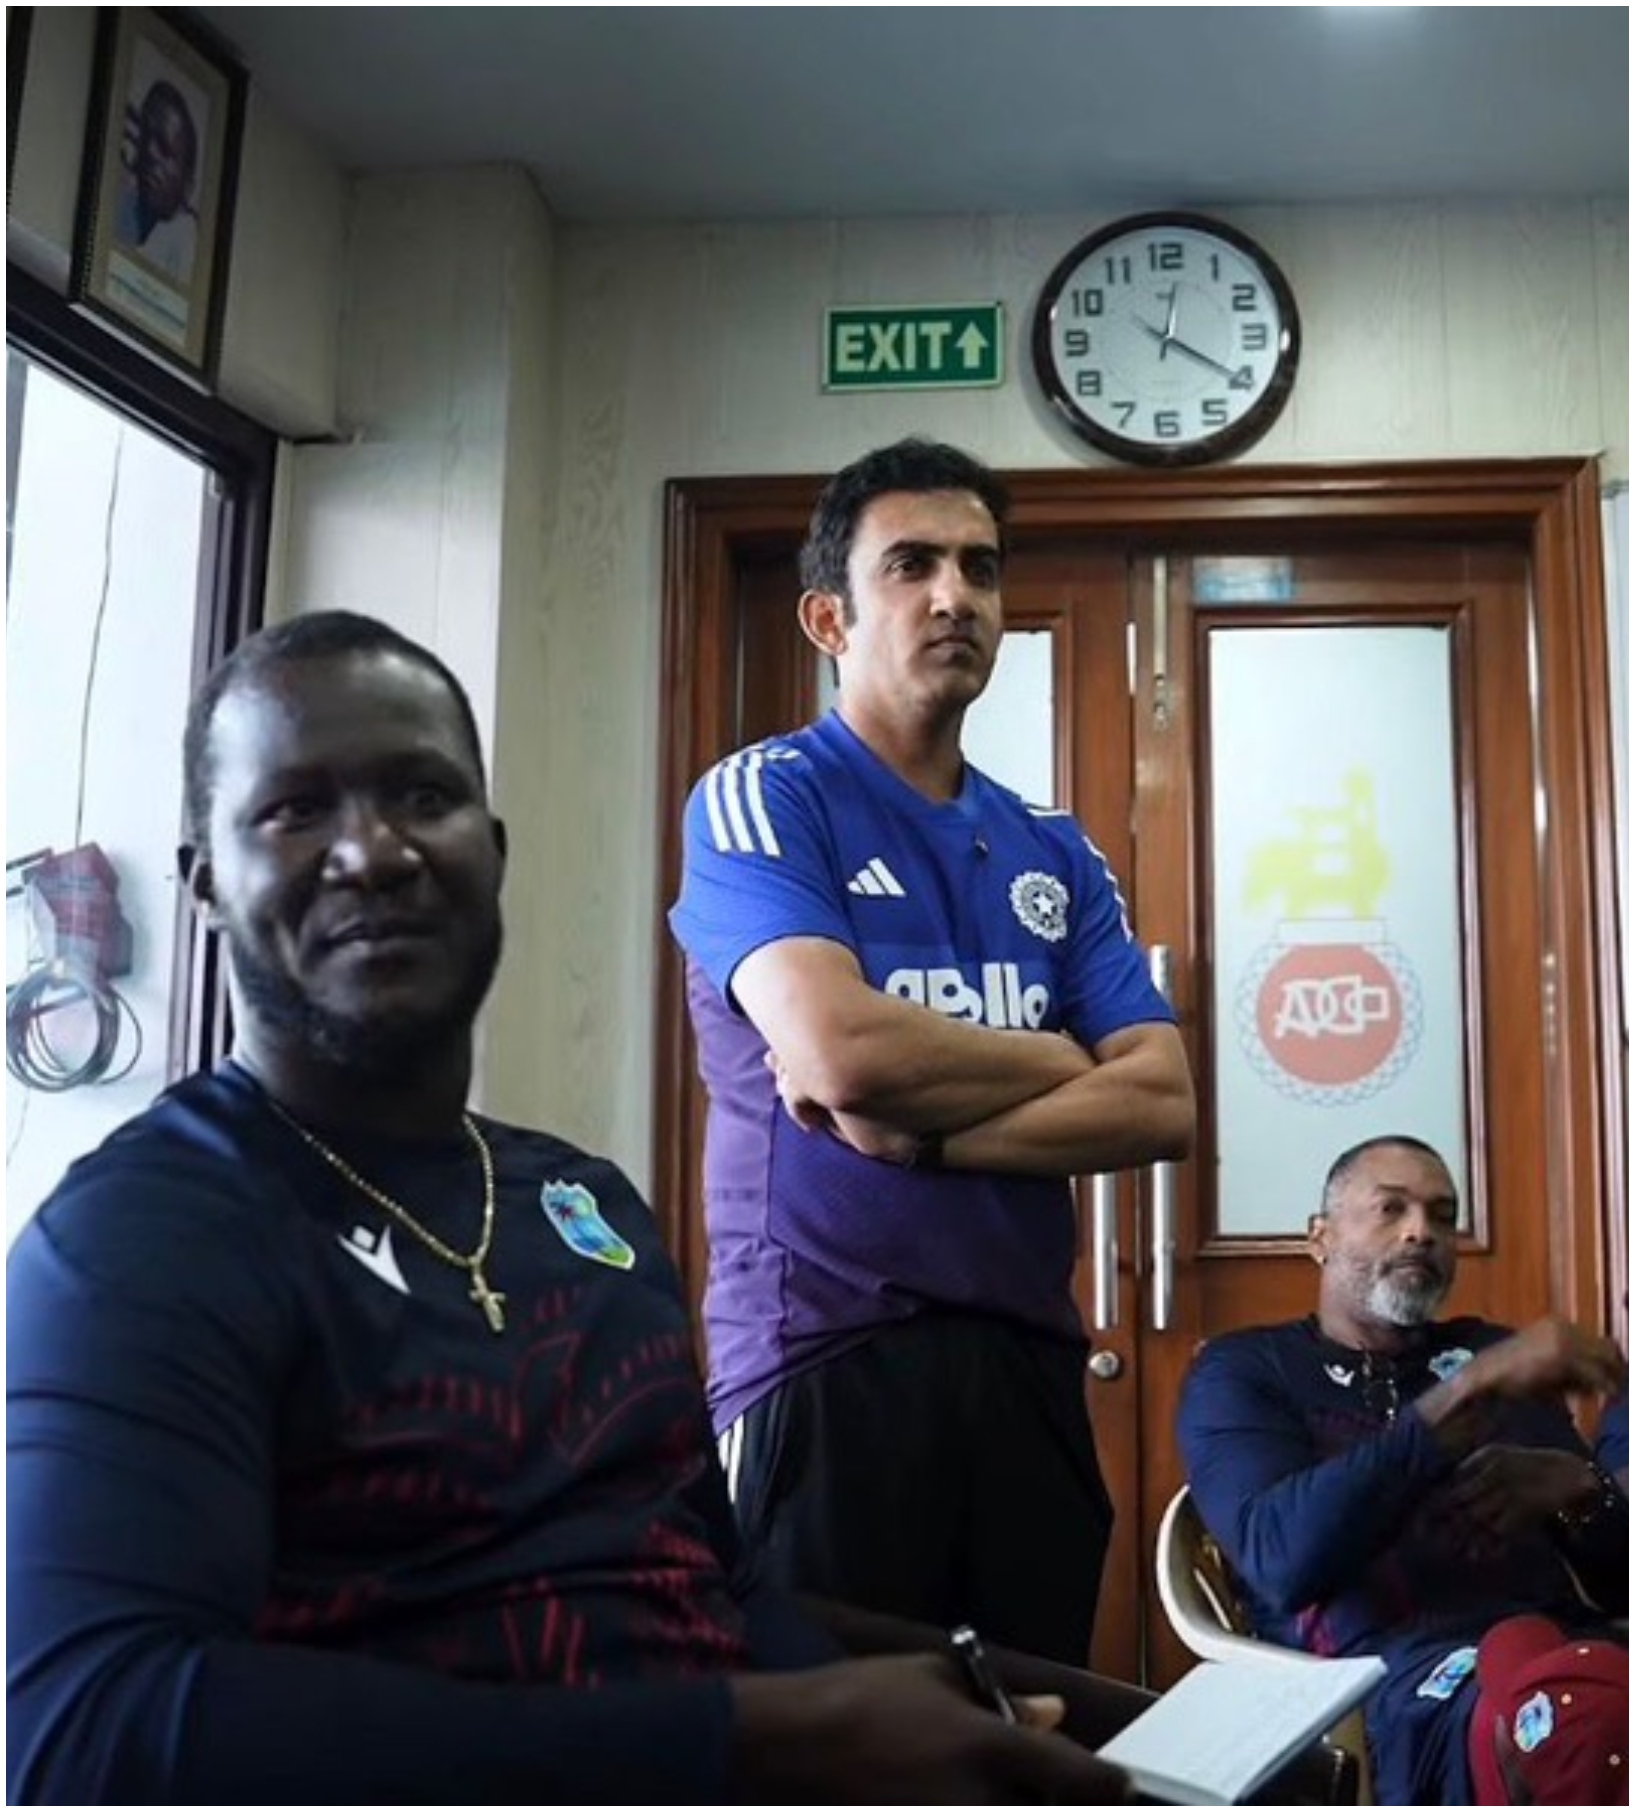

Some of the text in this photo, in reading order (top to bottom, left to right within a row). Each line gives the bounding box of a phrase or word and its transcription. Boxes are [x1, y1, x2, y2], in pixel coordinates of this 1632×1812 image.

[1105, 256, 1131, 284] 11
[1149, 243, 1184, 271] 12
[1208, 253, 1220, 282] 1
[1072, 289, 1104, 317] 10
[1231, 283, 1256, 312] 2
[835, 321, 952, 373] EXIT
[1065, 329, 1090, 358] 9
[1242, 323, 1267, 351] 3
[1076, 369, 1103, 397] 8
[1110, 400, 1137, 427] 7
[1153, 409, 1180, 437] 6
[1201, 398, 1228, 426] 5
